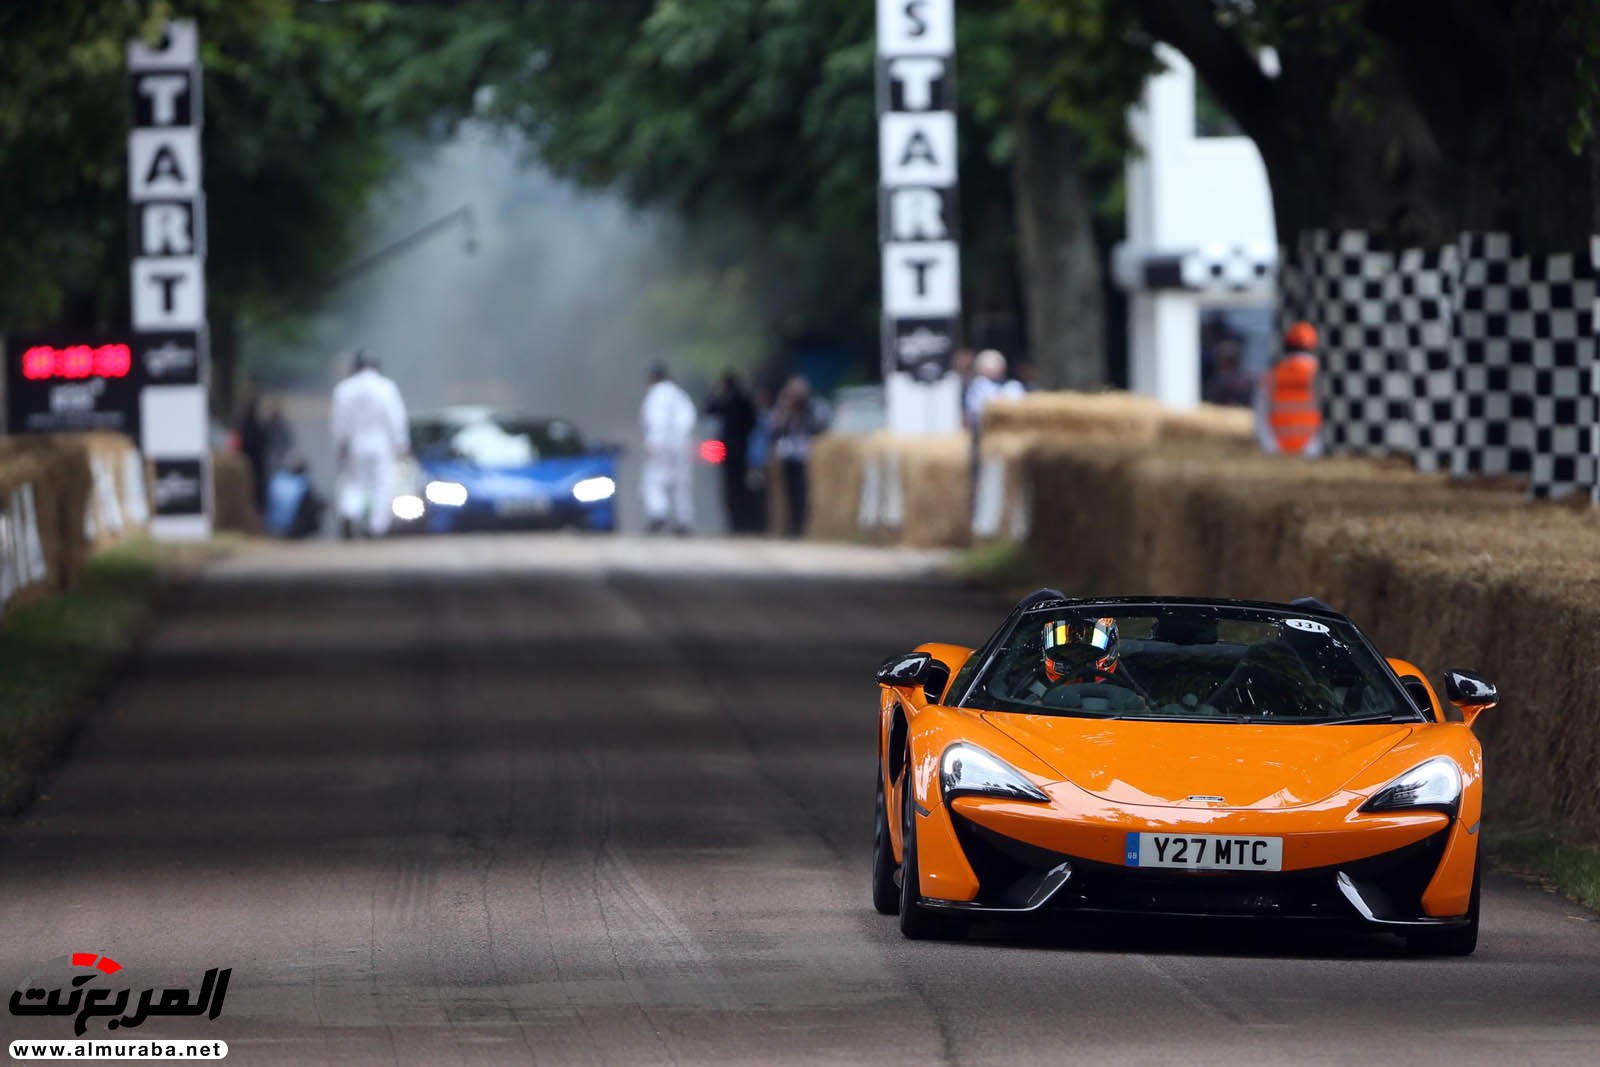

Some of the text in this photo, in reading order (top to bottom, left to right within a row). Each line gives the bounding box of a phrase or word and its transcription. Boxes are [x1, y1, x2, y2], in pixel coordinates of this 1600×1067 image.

[889, 0, 947, 297] START
[1154, 837, 1268, 866] Y27 MTC
